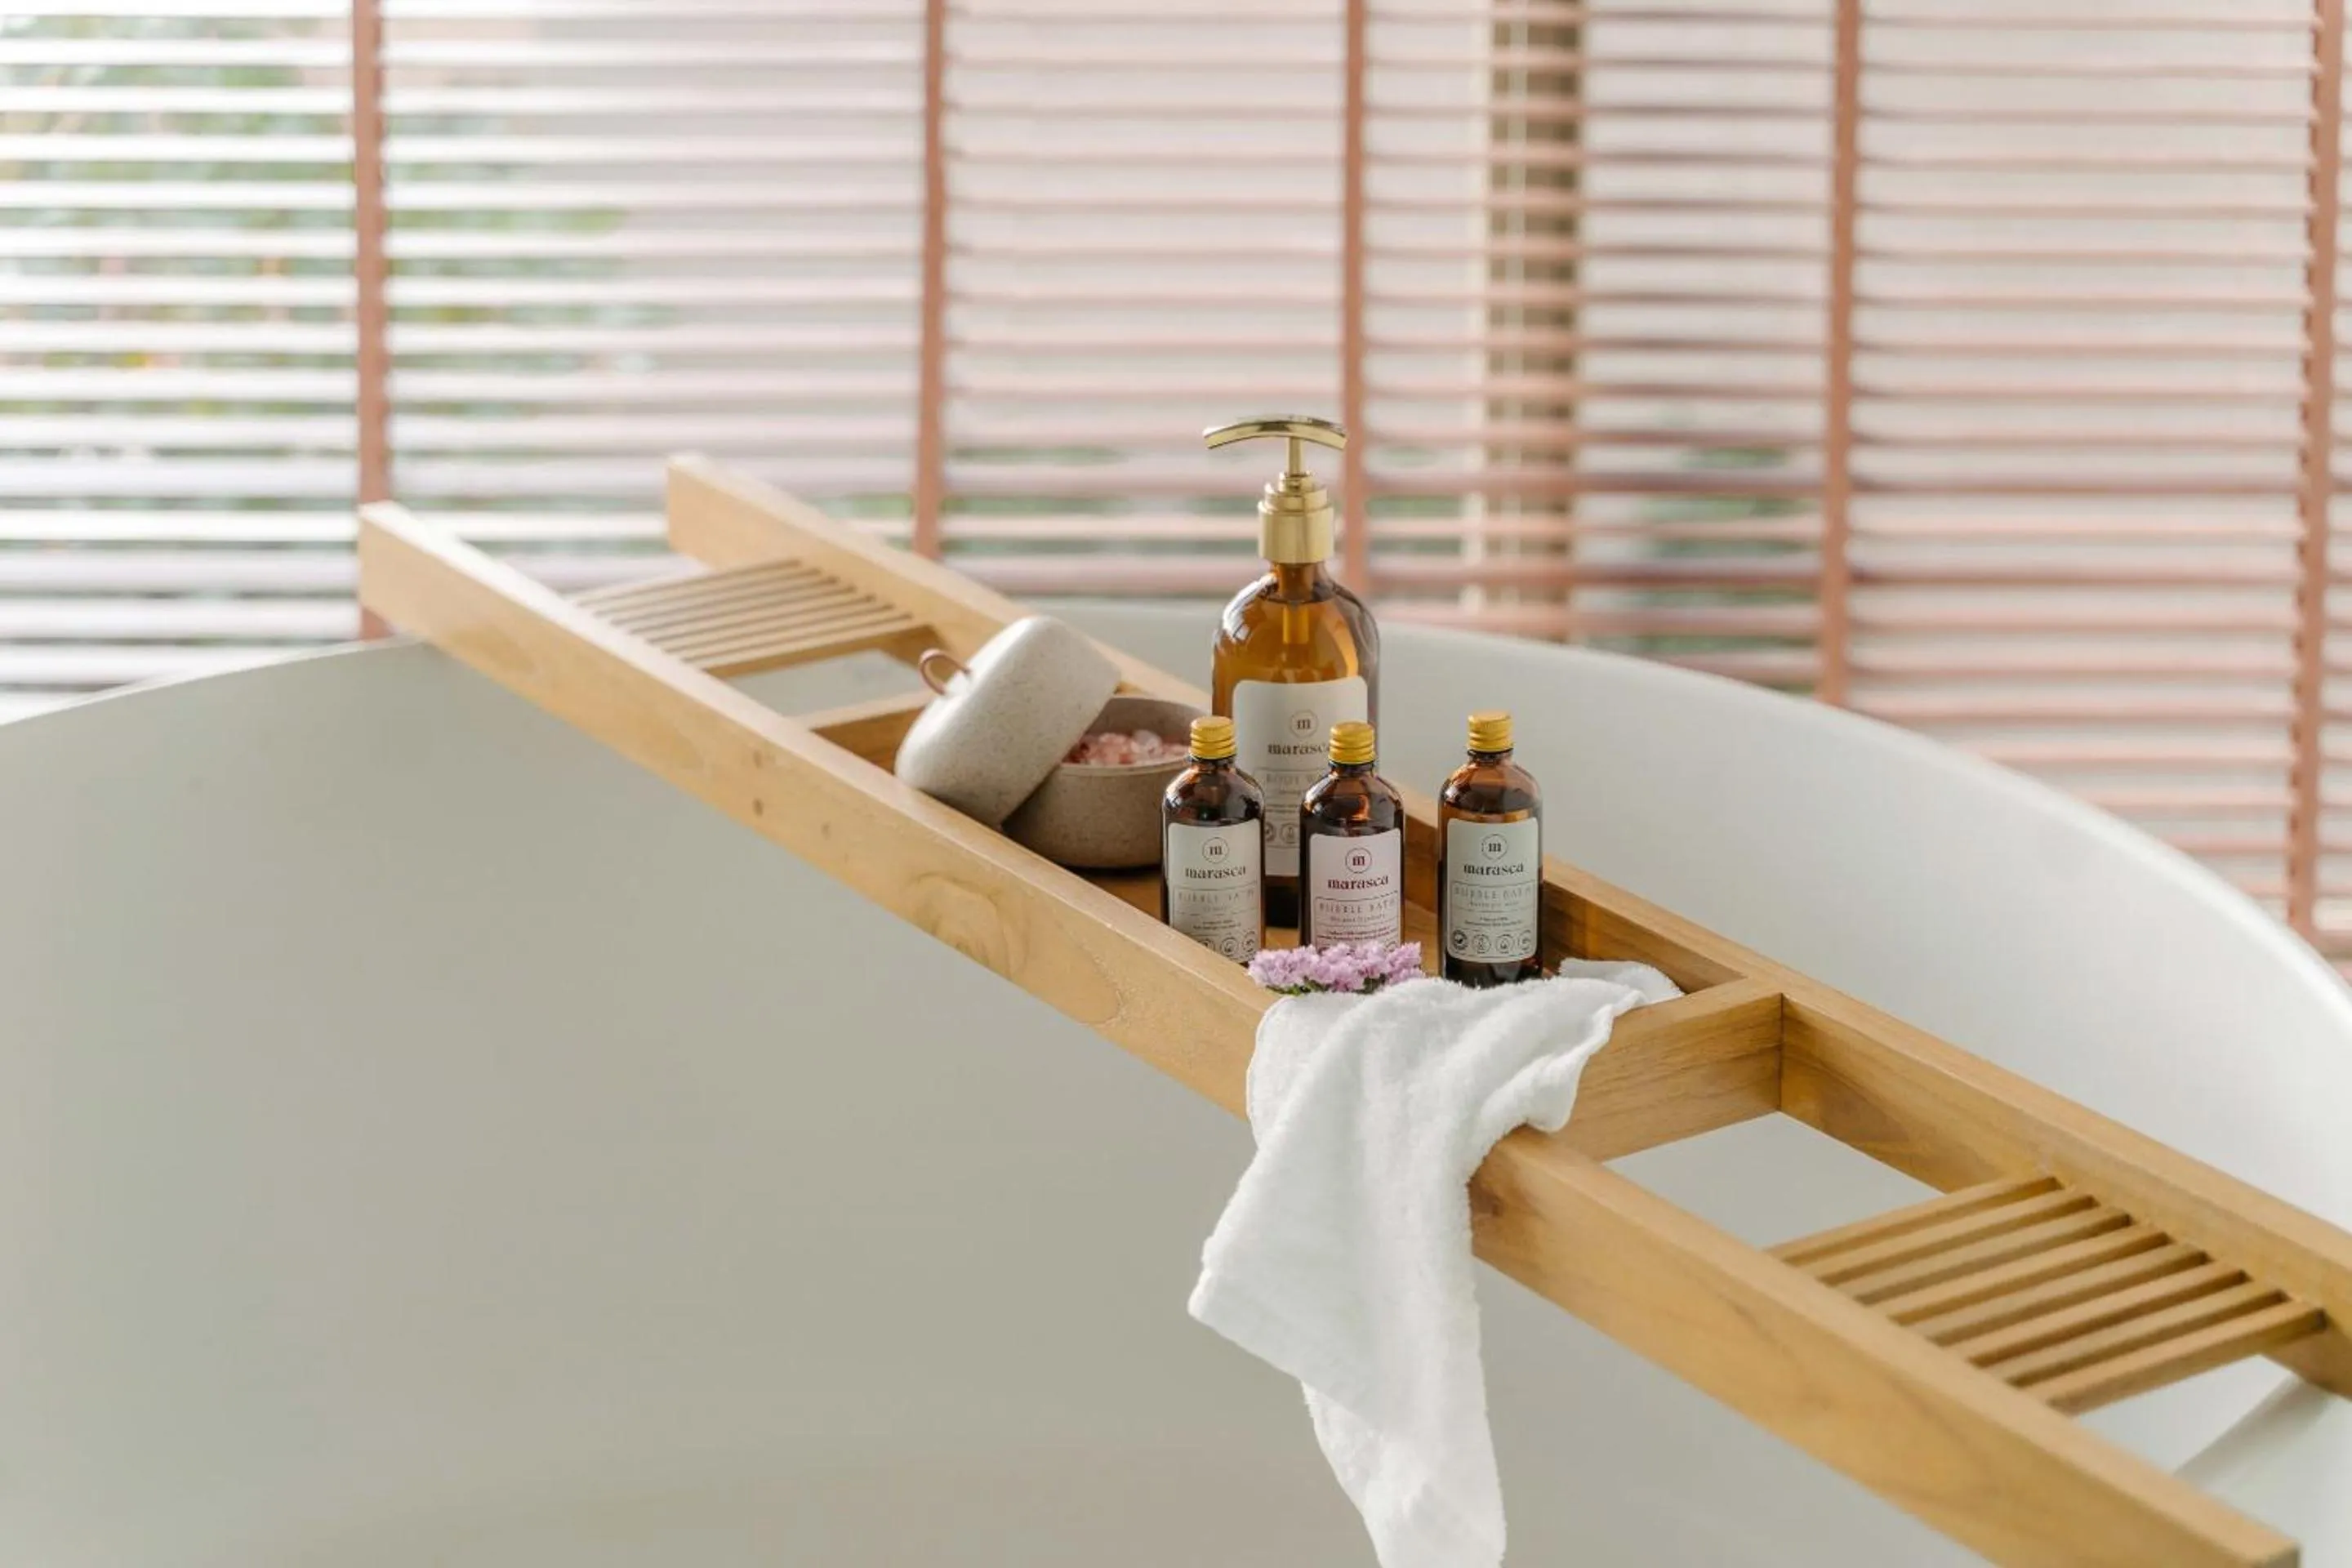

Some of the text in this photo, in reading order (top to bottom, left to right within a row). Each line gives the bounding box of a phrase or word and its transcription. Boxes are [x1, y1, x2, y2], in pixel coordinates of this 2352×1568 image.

[1209, 845, 1223, 856] m
[1488, 842, 1502, 853] m
[1352, 855, 1365, 866] m
[1185, 866, 1246, 879] marasca
[1463, 862, 1524, 876] marasca
[1327, 875, 1389, 889] marasca
